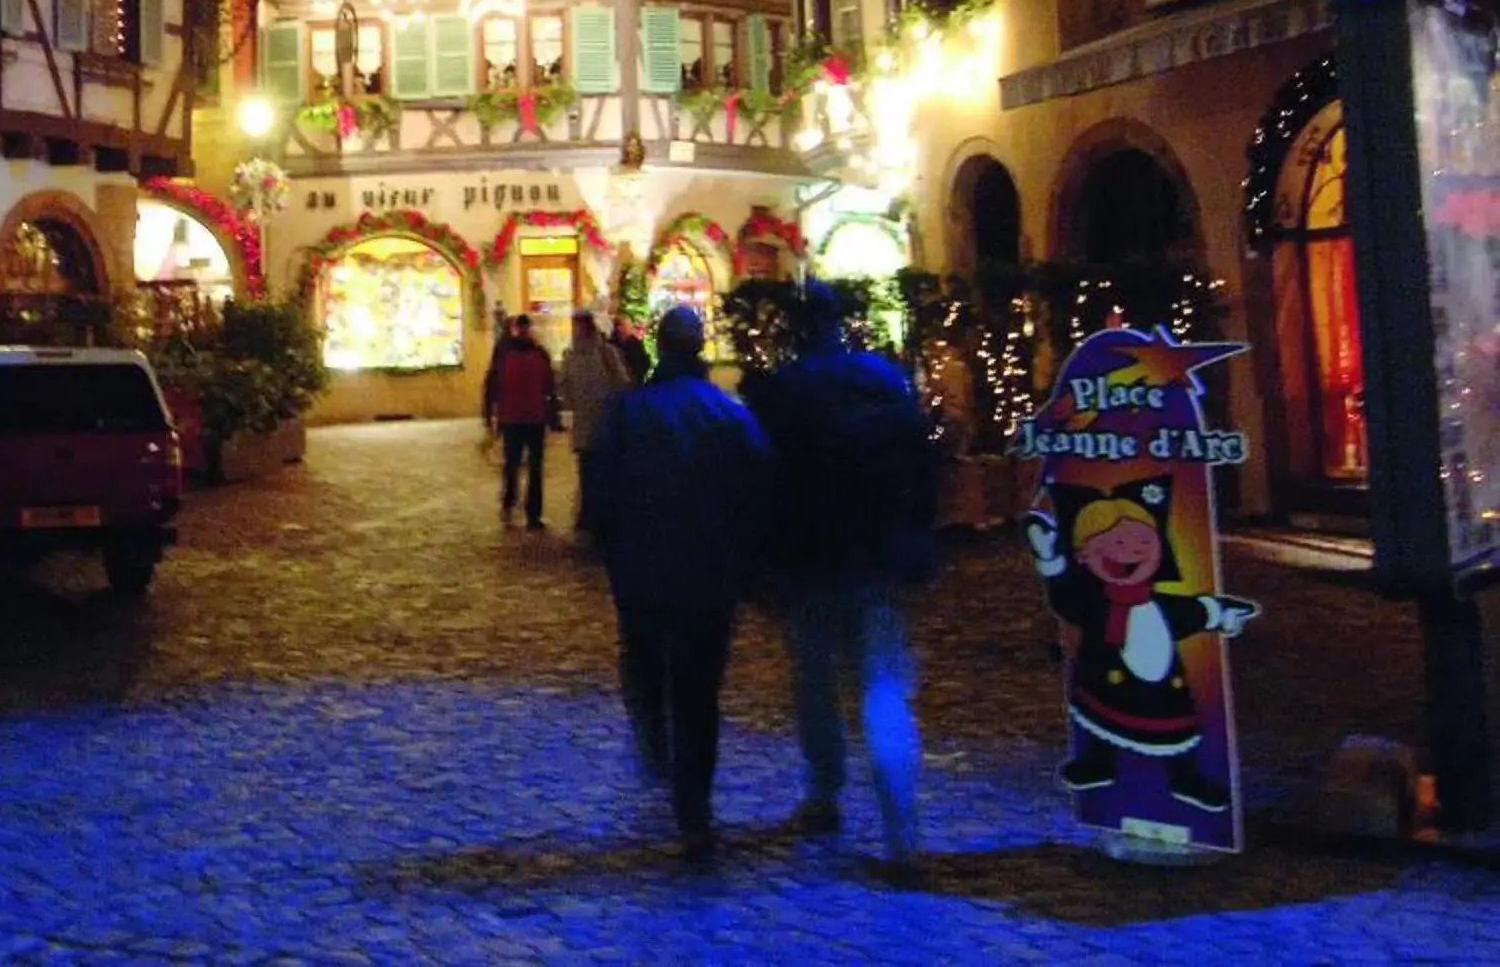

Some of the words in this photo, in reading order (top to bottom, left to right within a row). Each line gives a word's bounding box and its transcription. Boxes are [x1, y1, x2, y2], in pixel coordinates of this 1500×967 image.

[304, 190, 336, 209] au
[1070, 376, 1164, 411] Place
[1019, 420, 1138, 460] Jeanne
[1149, 428, 1241, 460] d'Arc
